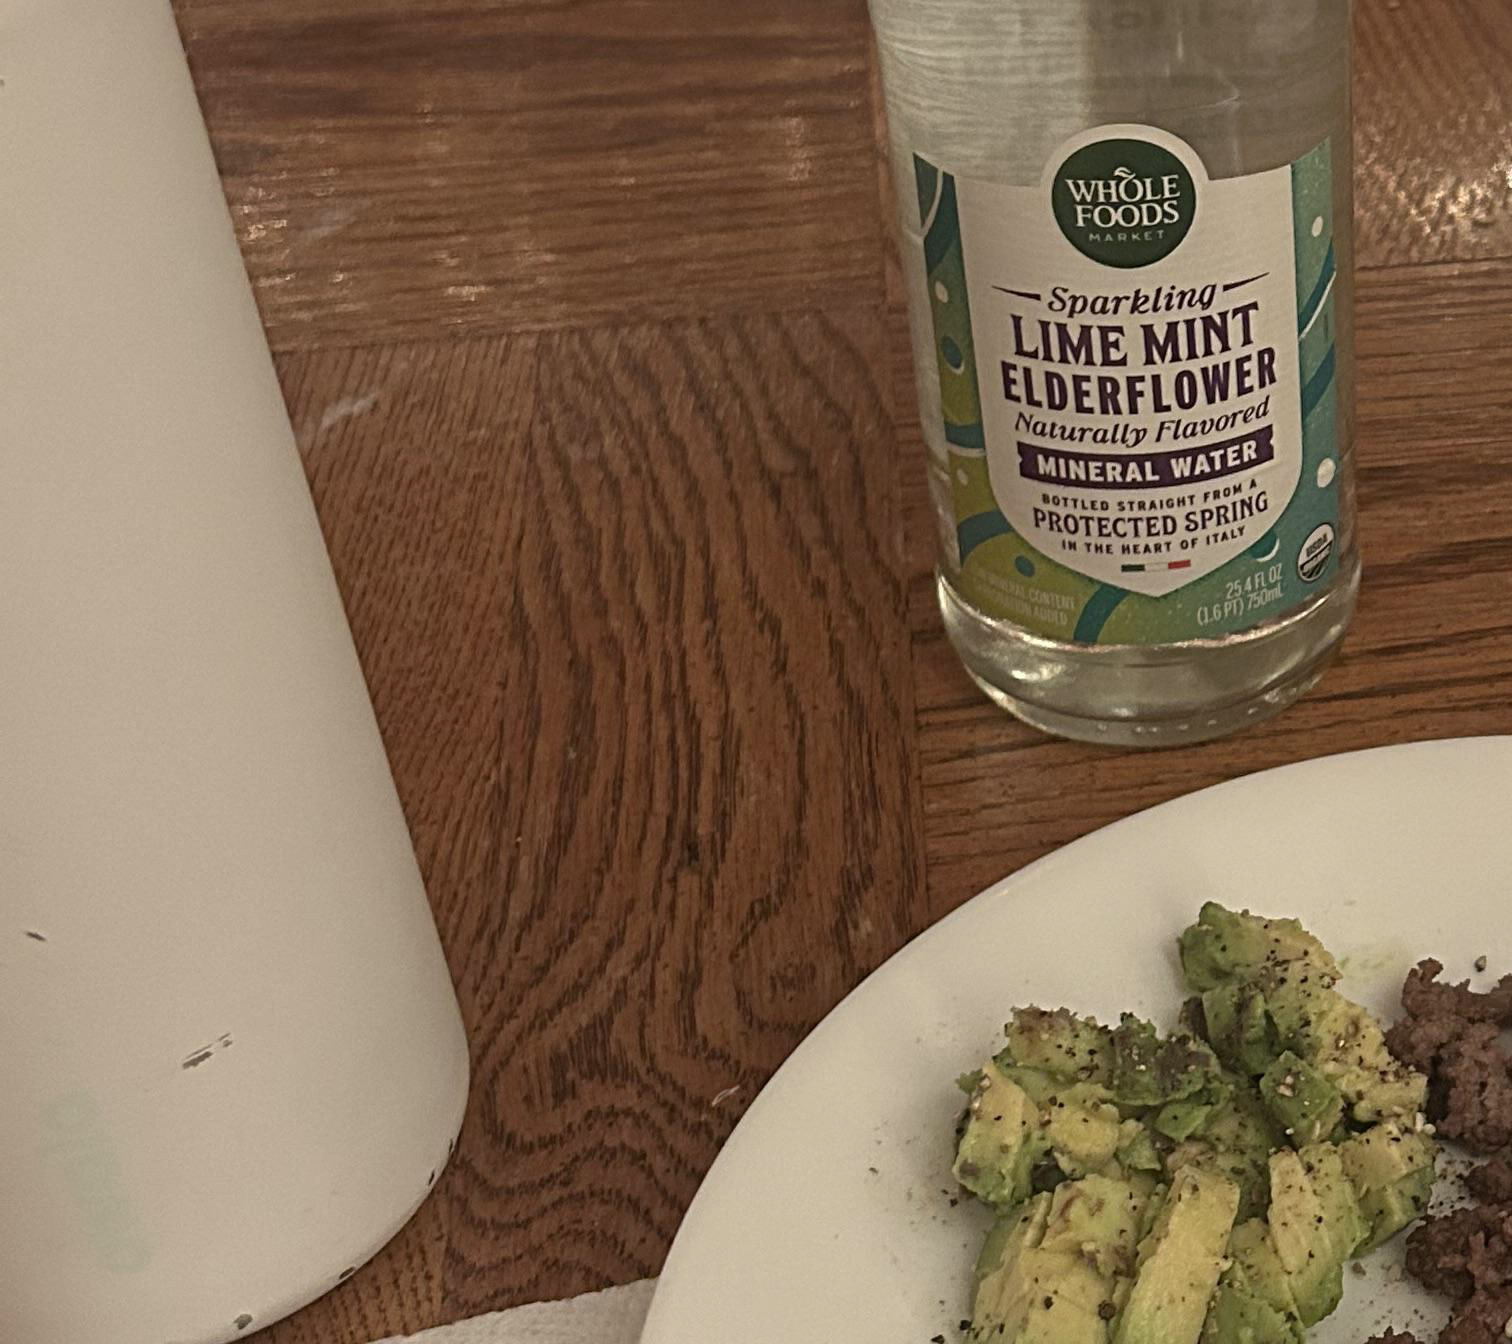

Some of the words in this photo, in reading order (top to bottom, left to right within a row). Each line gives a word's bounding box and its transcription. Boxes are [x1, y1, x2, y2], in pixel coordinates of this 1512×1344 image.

[1064, 169, 1181, 203] WHOLE
[1075, 200, 1180, 228] FOODS
[1088, 230, 1165, 242] MARKET
[1047, 284, 1217, 318] Sparkling
[1010, 313, 1128, 367] LIME
[1140, 301, 1259, 366] MINT
[1001, 347, 1277, 415] ELDERFLOWER
[1015, 411, 1148, 448] Naturally
[1155, 395, 1271, 442] Flavored
[1037, 454, 1160, 483] MINERAL
[1170, 440, 1257, 479] WATER
[1041, 493, 1110, 511] BOTTLED
[1117, 494, 1196, 512] STRAIGHT
[1203, 483, 1243, 503] FROM
[1249, 478, 1257, 489] A
[1033, 507, 1177, 538] PROTECTED
[1184, 491, 1269, 532] SPRING
[1062, 539, 1077, 551] IN
[1086, 542, 1114, 554] THE
[1121, 542, 1171, 555] HEART
[1180, 538, 1199, 550] OF
[1206, 525, 1245, 546] ITALY
[1254, 570, 1265, 589] FL
[1268, 563, 1283, 581] OZ
